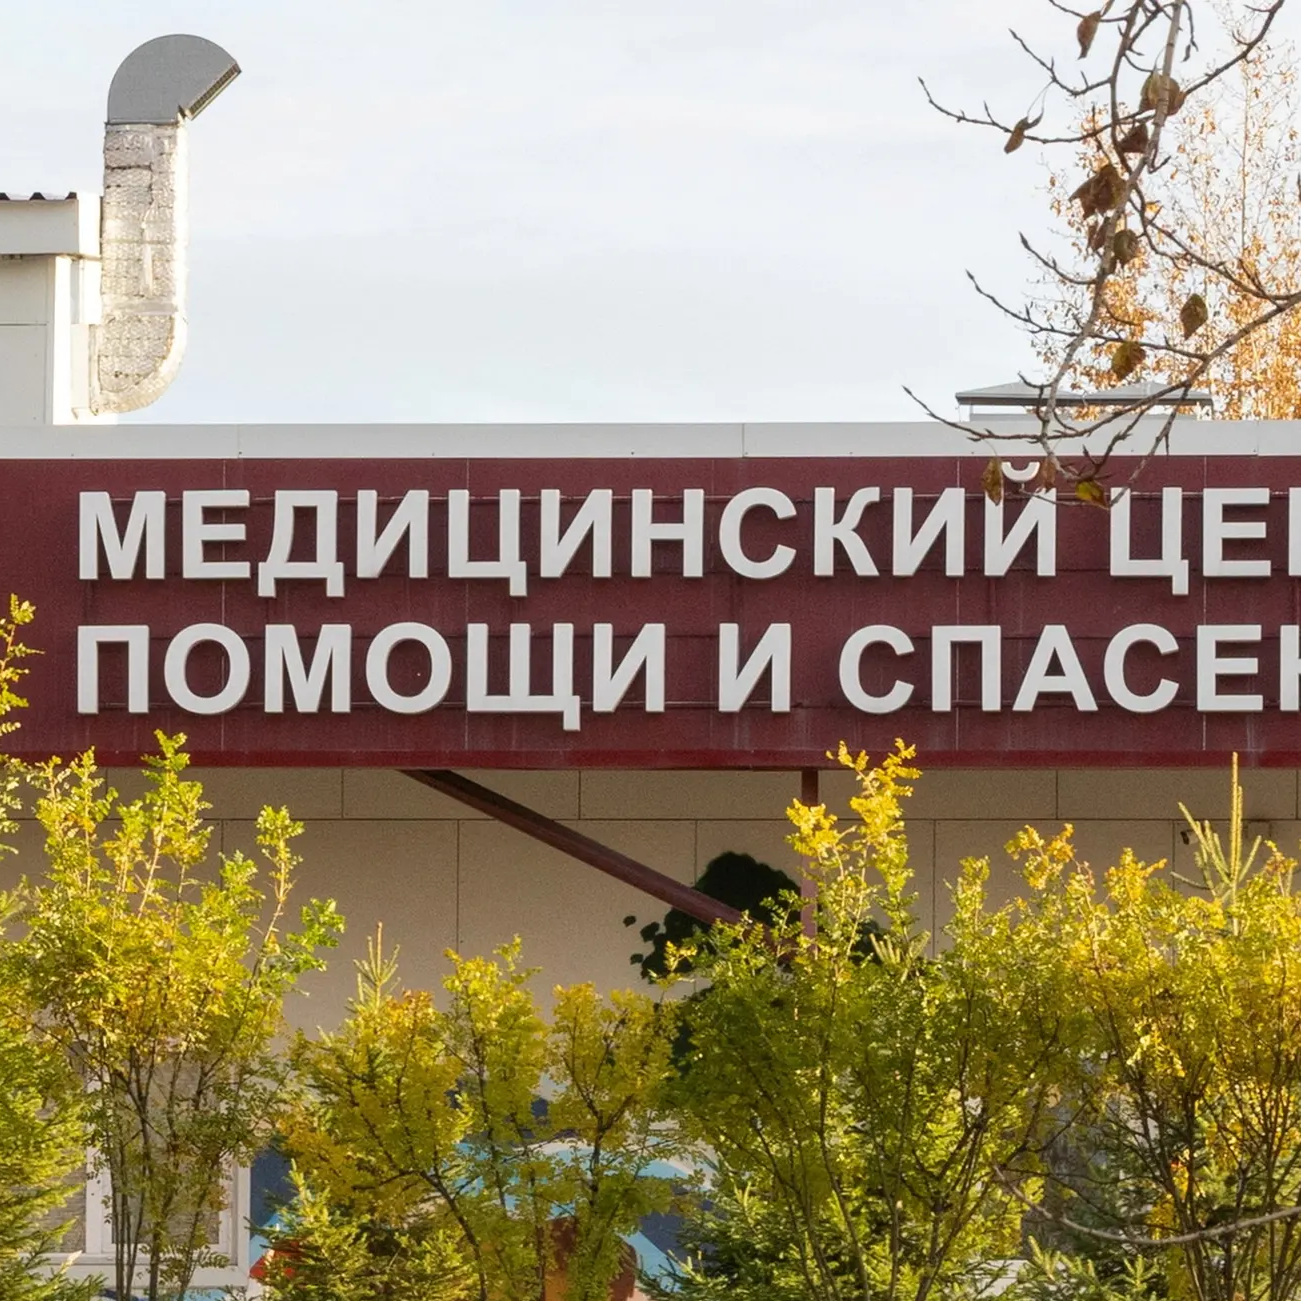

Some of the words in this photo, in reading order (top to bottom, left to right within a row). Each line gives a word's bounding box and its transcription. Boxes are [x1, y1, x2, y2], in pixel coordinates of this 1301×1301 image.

[78, 461, 1057, 598] МЕДИЦИНСКИЙ
[1110, 487, 1301, 595] ЦЕ
[77, 621, 666, 731] ПОМОЩИ
[718, 622, 792, 713] И
